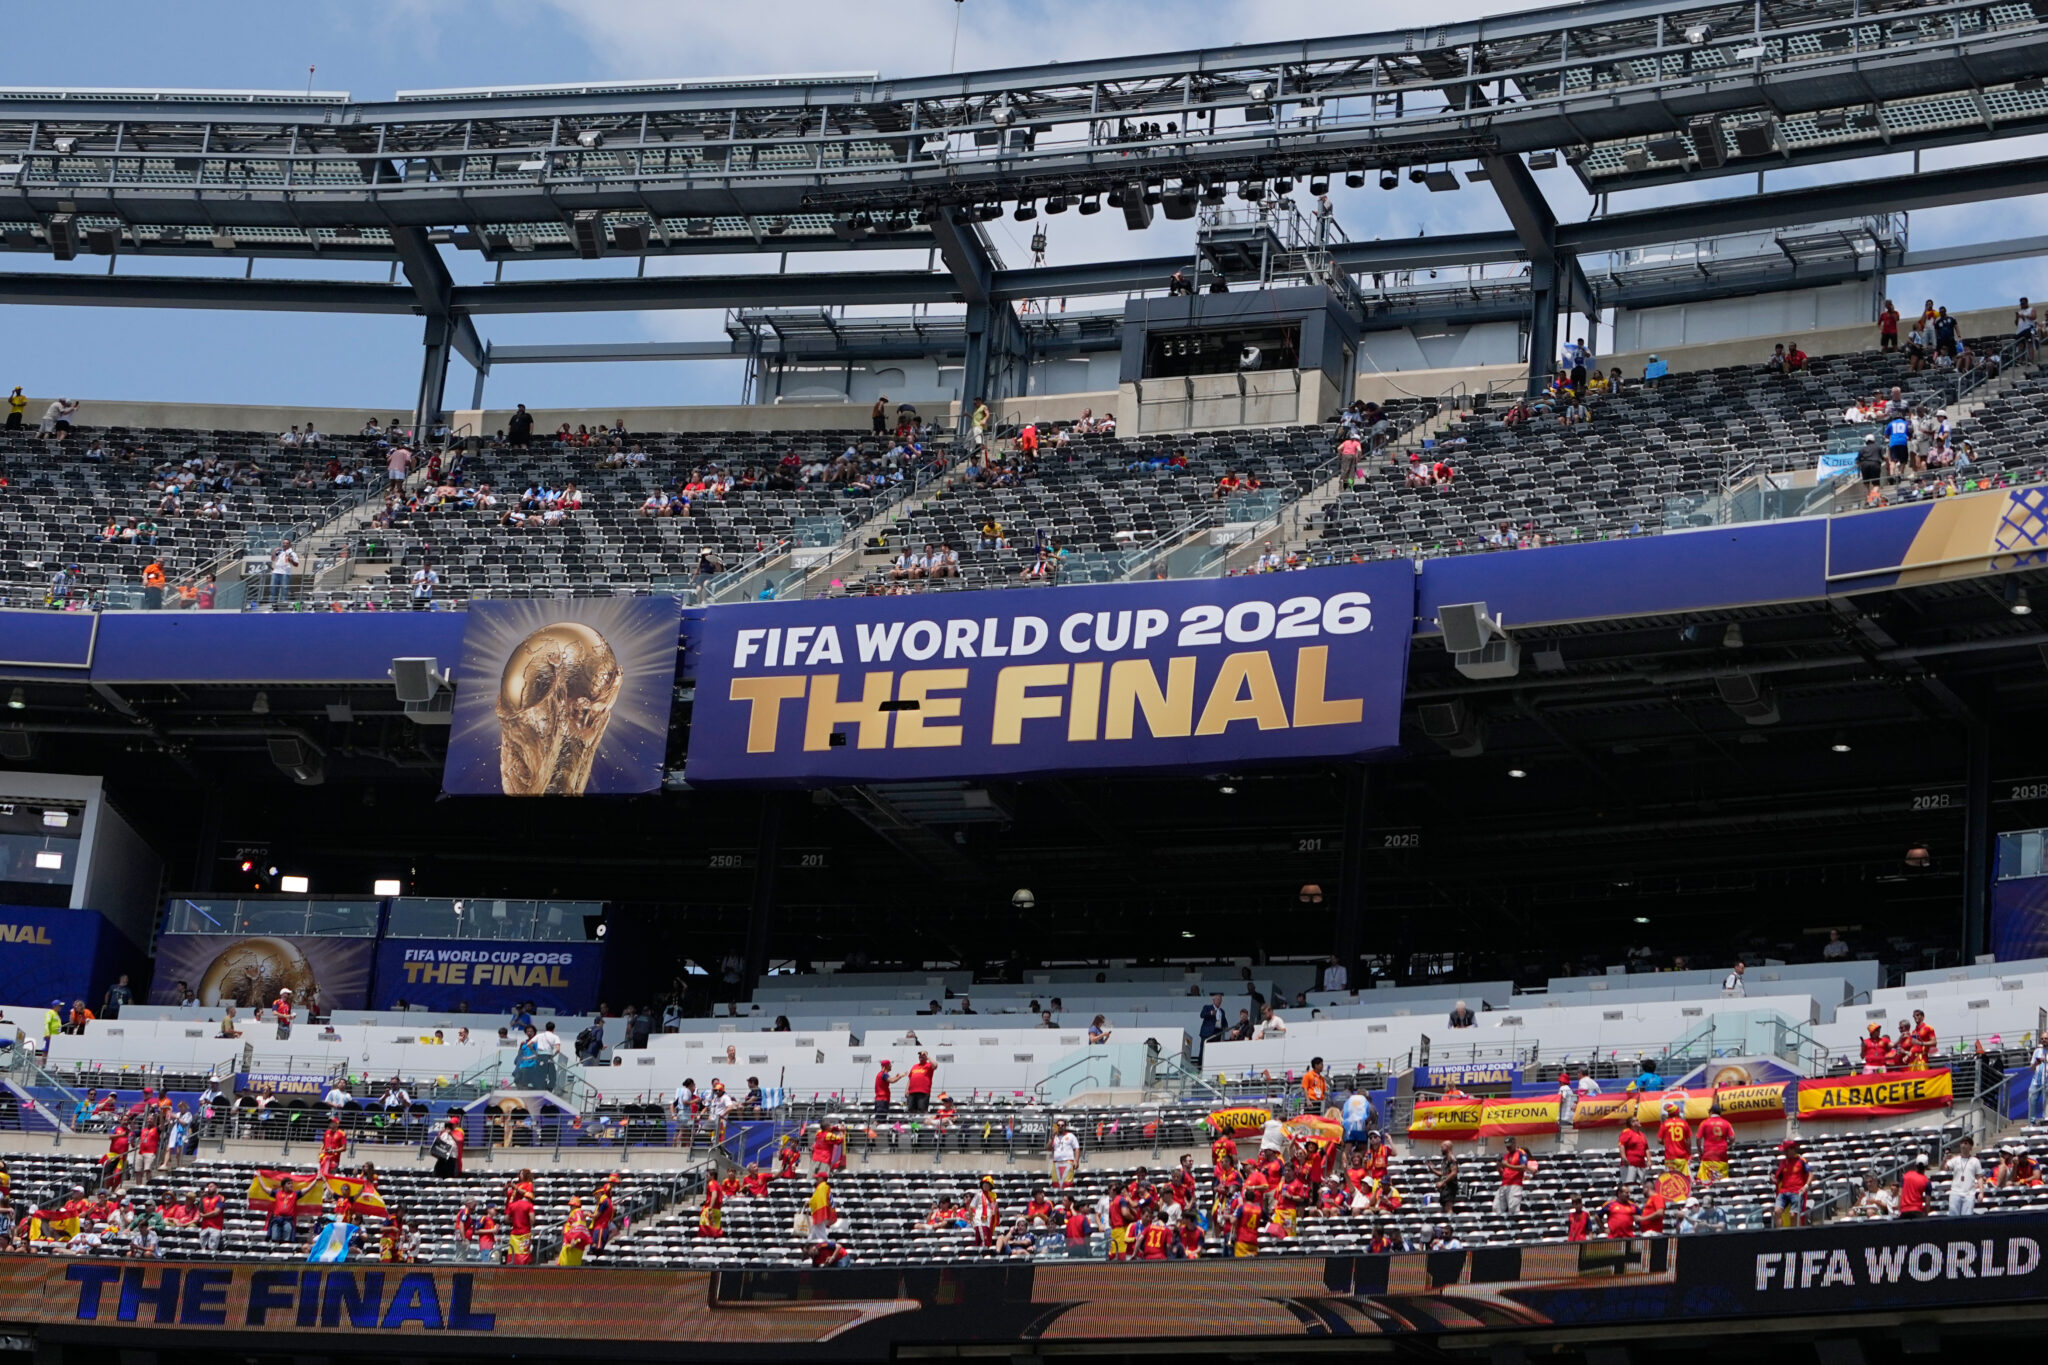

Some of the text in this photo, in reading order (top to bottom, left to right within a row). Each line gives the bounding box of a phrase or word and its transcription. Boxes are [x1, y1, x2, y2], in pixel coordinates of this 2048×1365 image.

[1892, 422, 1906, 434] 10
[733, 592, 1372, 668] FIFA WORLD CUP 2026
[730, 645, 1365, 754] THE FINAL
[1913, 793, 1950, 808] 202B
[1299, 839, 1321, 851] 201
[1384, 834, 1419, 847] 202B
[709, 855, 743, 867] 250B
[801, 854, 824, 866] 201
[405, 949, 573, 965] FIFA WORLD CUP 2026
[403, 962, 569, 987] THE FINAL
[1428, 1062, 1514, 1074] FIFA WORLD CUP 2026
[1429, 1070, 1513, 1086] THE FINAL
[247, 1080, 321, 1093] THE FINAL
[1821, 1080, 1926, 1107] ALBACETE
[1721, 1088, 1779, 1101] LHAURIN
[1729, 1098, 1776, 1110] GRANDE
[1437, 1111, 1478, 1124] FUNES
[1487, 1107, 1548, 1119] ESTEPONA
[1021, 1123, 1045, 1132] 202A
[1669, 1126, 1683, 1141] 19
[1247, 1214, 1257, 1230] 4
[1149, 1230, 1162, 1248] 11
[1755, 1237, 2041, 1291] FIFA WORLD
[65, 1263, 497, 1331] THE FINAL
